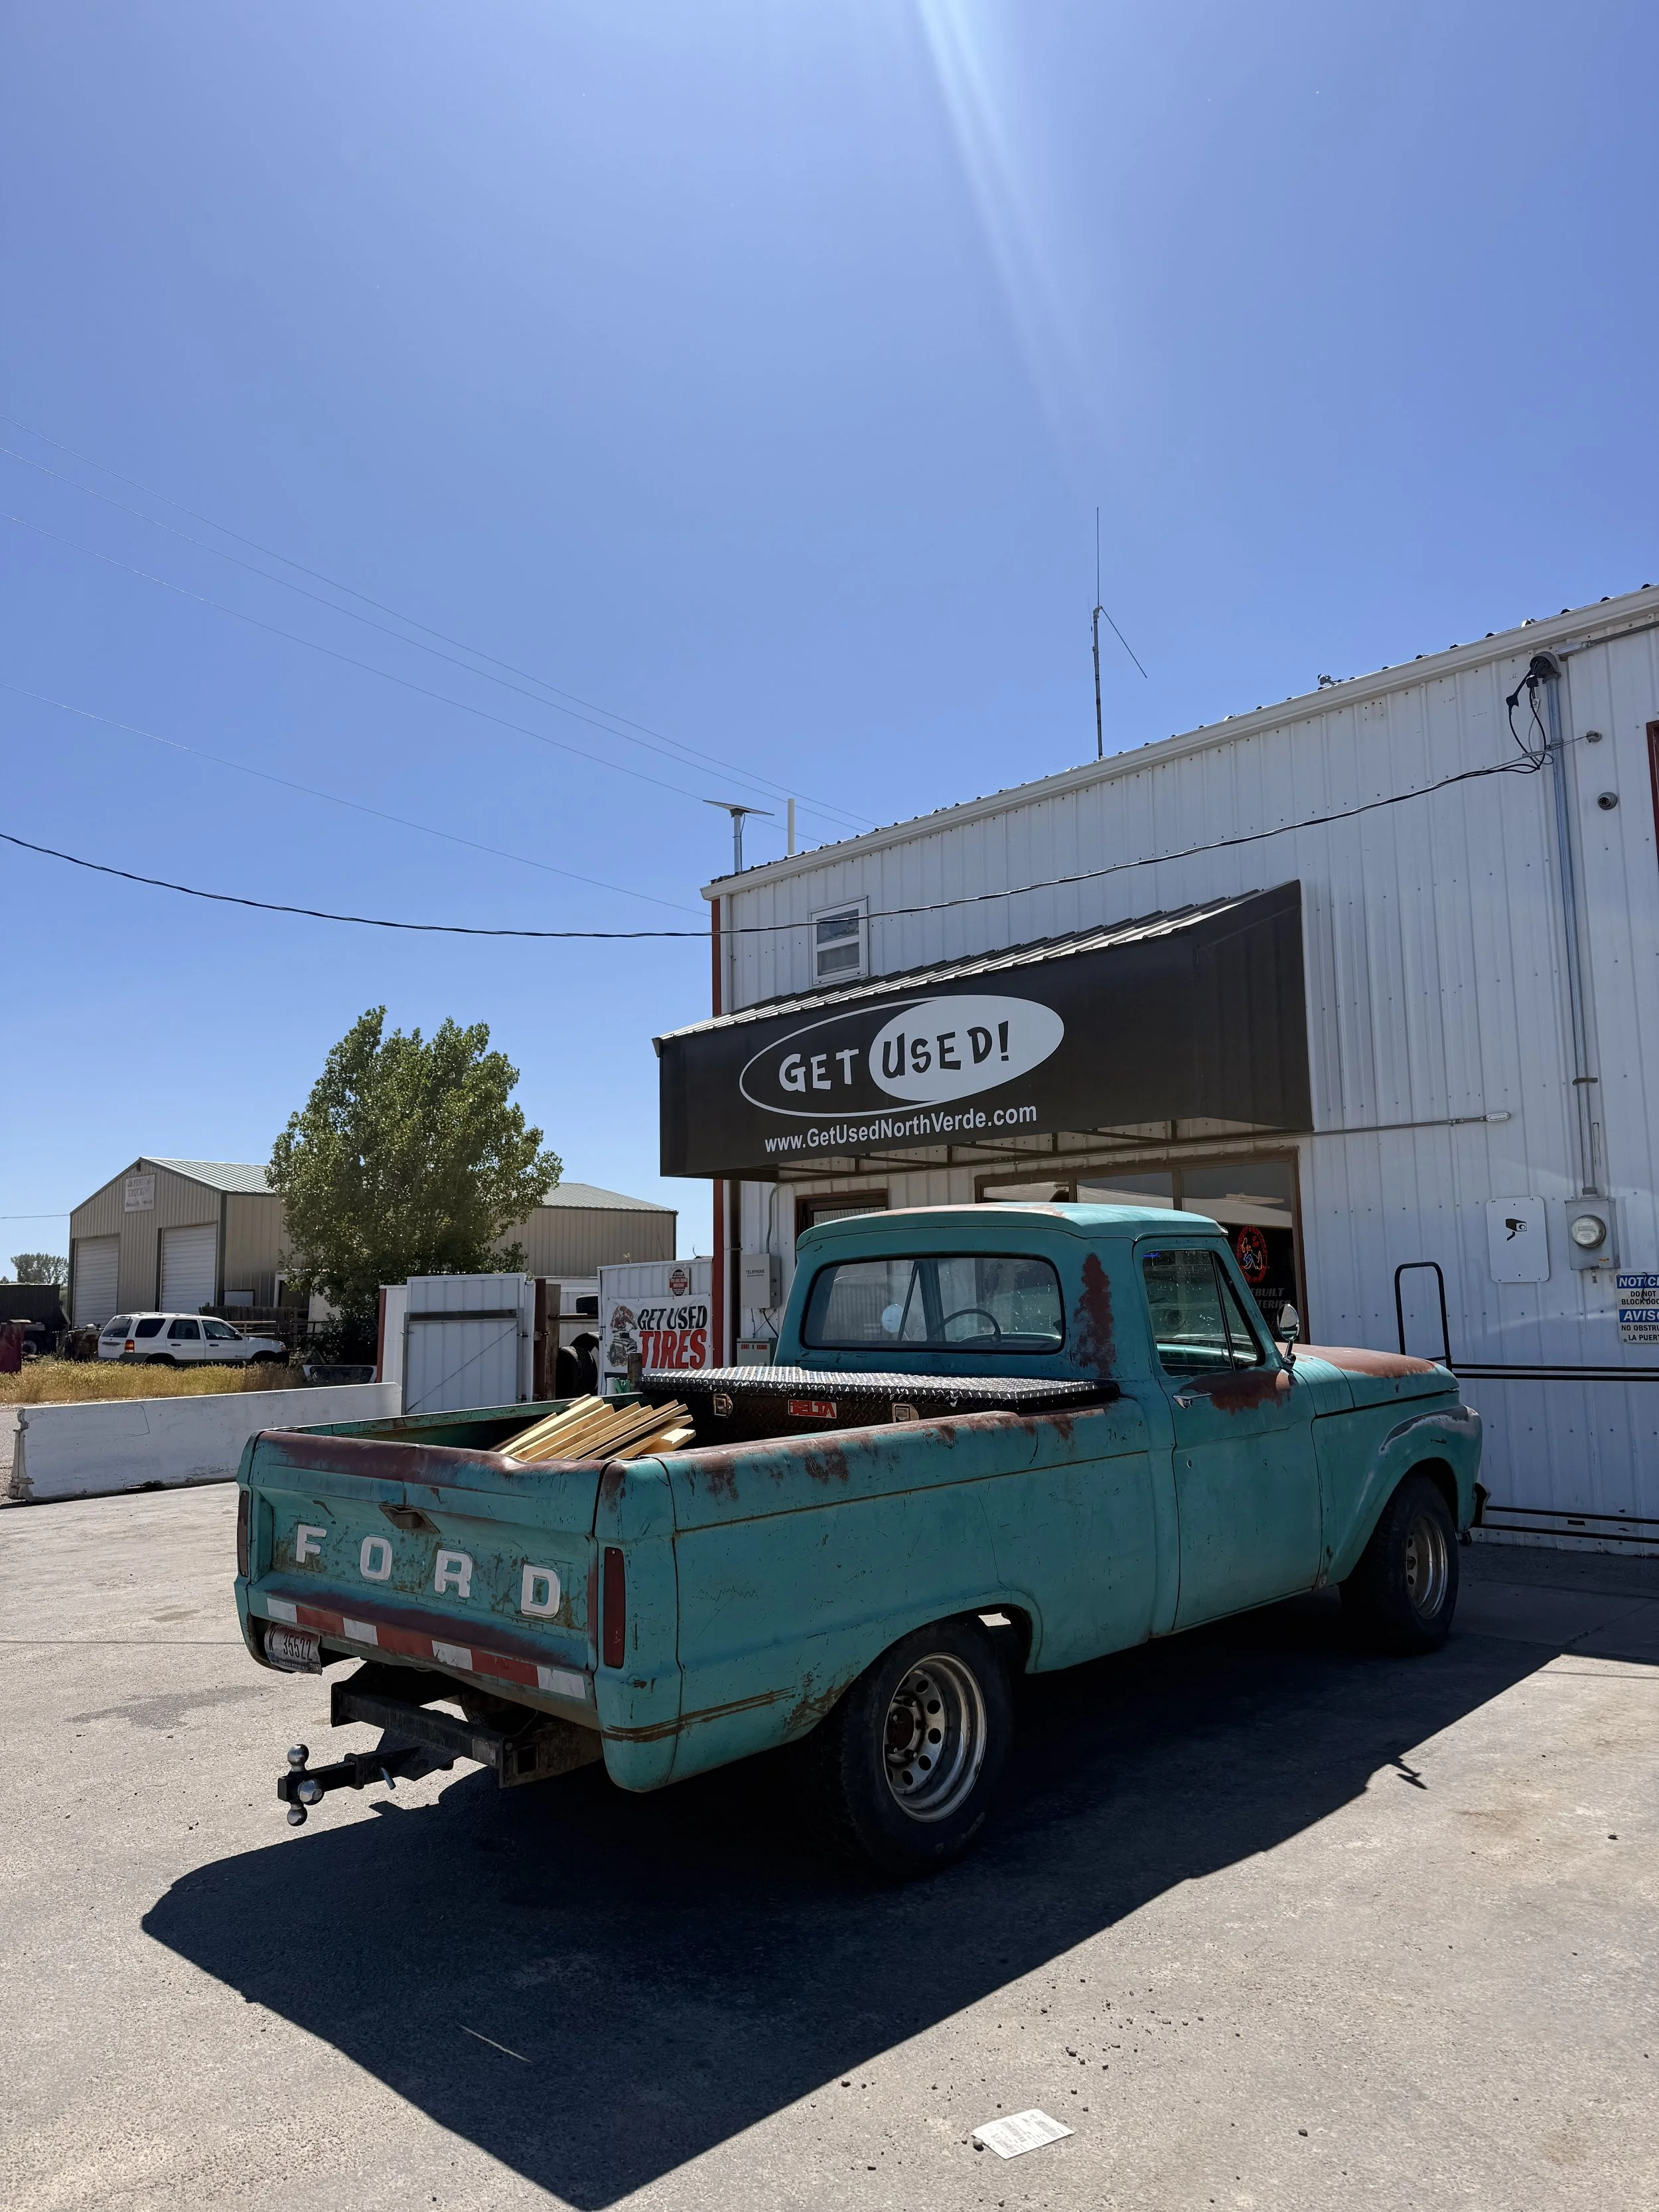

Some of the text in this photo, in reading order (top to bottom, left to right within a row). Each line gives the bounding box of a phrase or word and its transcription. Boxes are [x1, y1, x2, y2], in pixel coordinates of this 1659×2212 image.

[778, 1020, 1009, 1092] GET USED!
[764, 1105, 1037, 1153] www.GetUsedNorthVerde.com
[1251, 1288, 1285, 1297] EBUILT
[1257, 1299, 1291, 1309] TERIE
[637, 1305, 707, 1331] GET USED
[1623, 1310, 1659, 1321] AVIS
[639, 1329, 707, 1370] TIRES
[790, 1400, 836, 1418] DELTA
[295, 1523, 561, 1619] FORD
[283, 1633, 313, 1661] 35522
